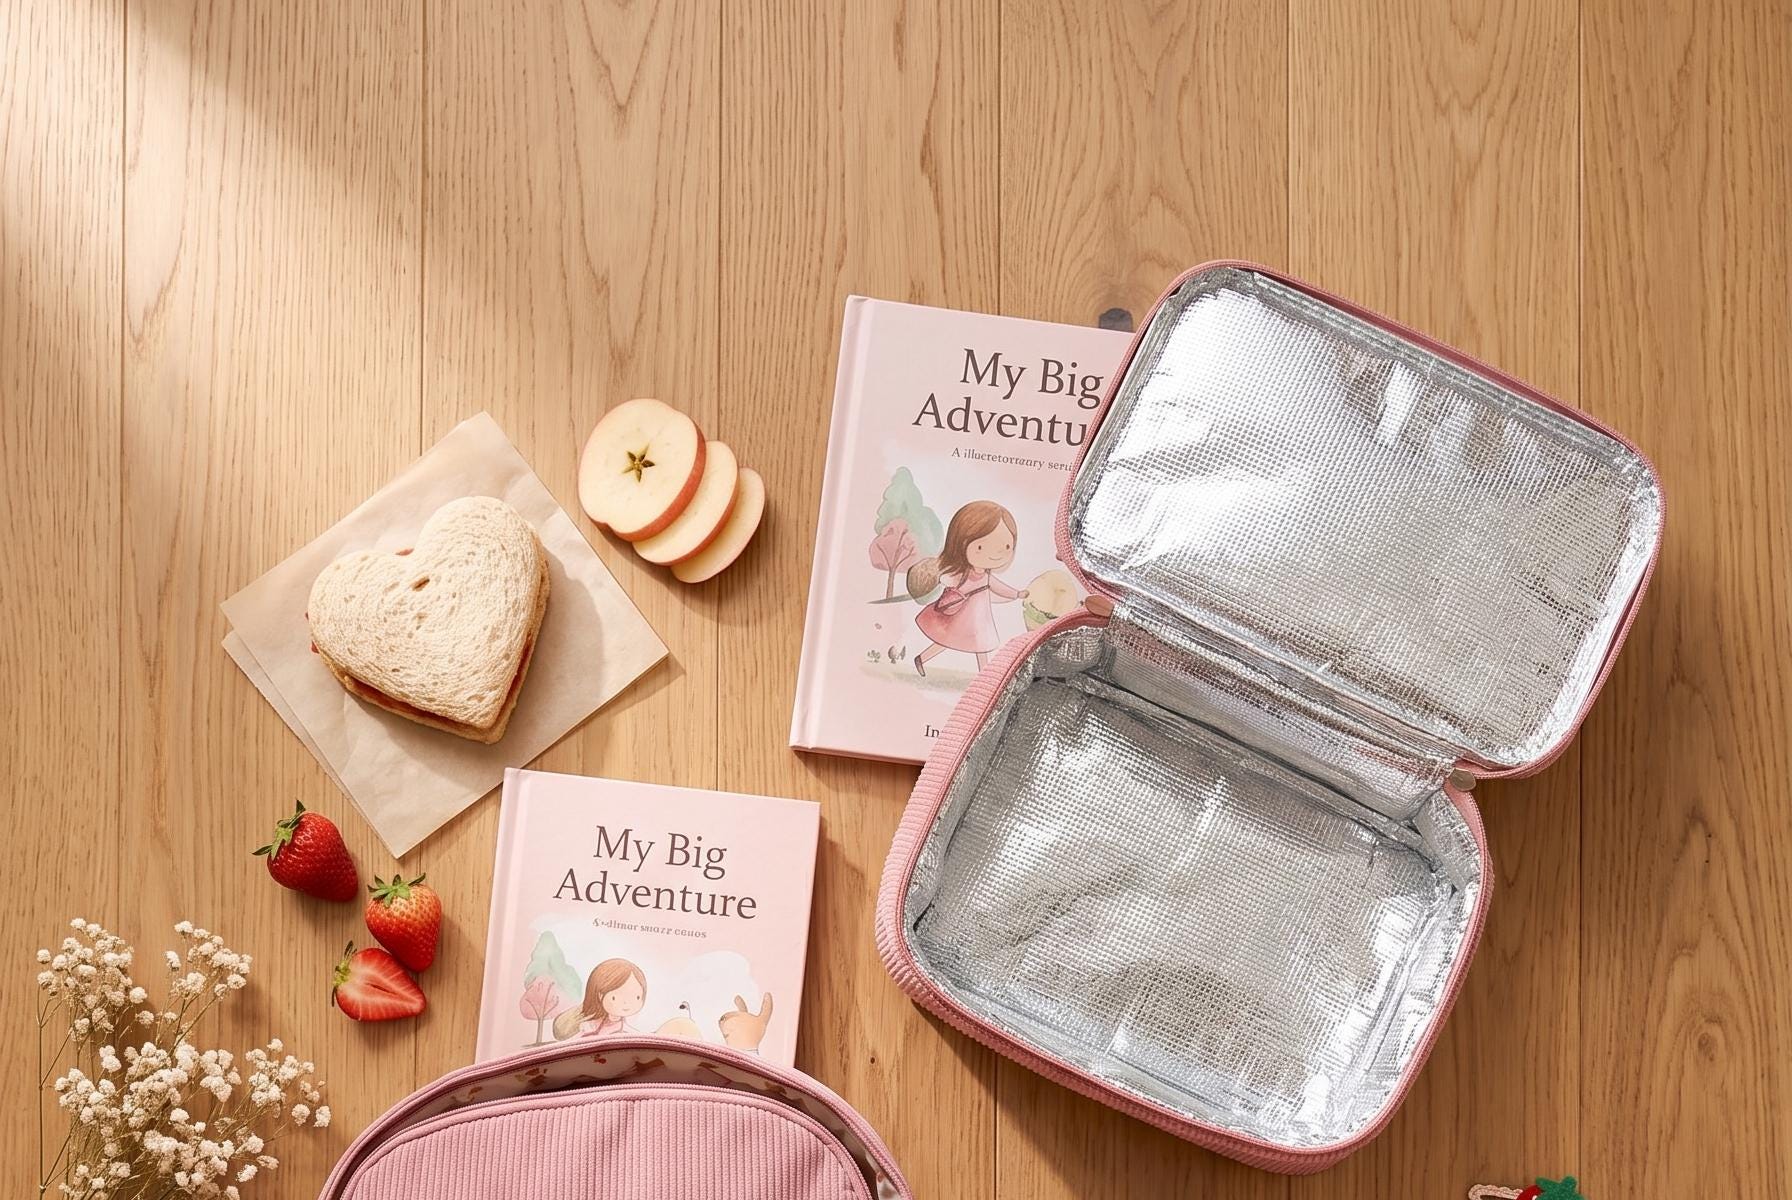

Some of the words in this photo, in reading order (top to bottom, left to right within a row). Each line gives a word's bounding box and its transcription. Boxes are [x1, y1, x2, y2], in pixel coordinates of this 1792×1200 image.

[960, 348, 1027, 400] My
[1038, 358, 1104, 410] Big
[912, 393, 1087, 446] Adventu
[951, 447, 961, 458] A
[593, 825, 655, 873] My
[665, 832, 728, 880] Big
[552, 868, 757, 920] Adventure
